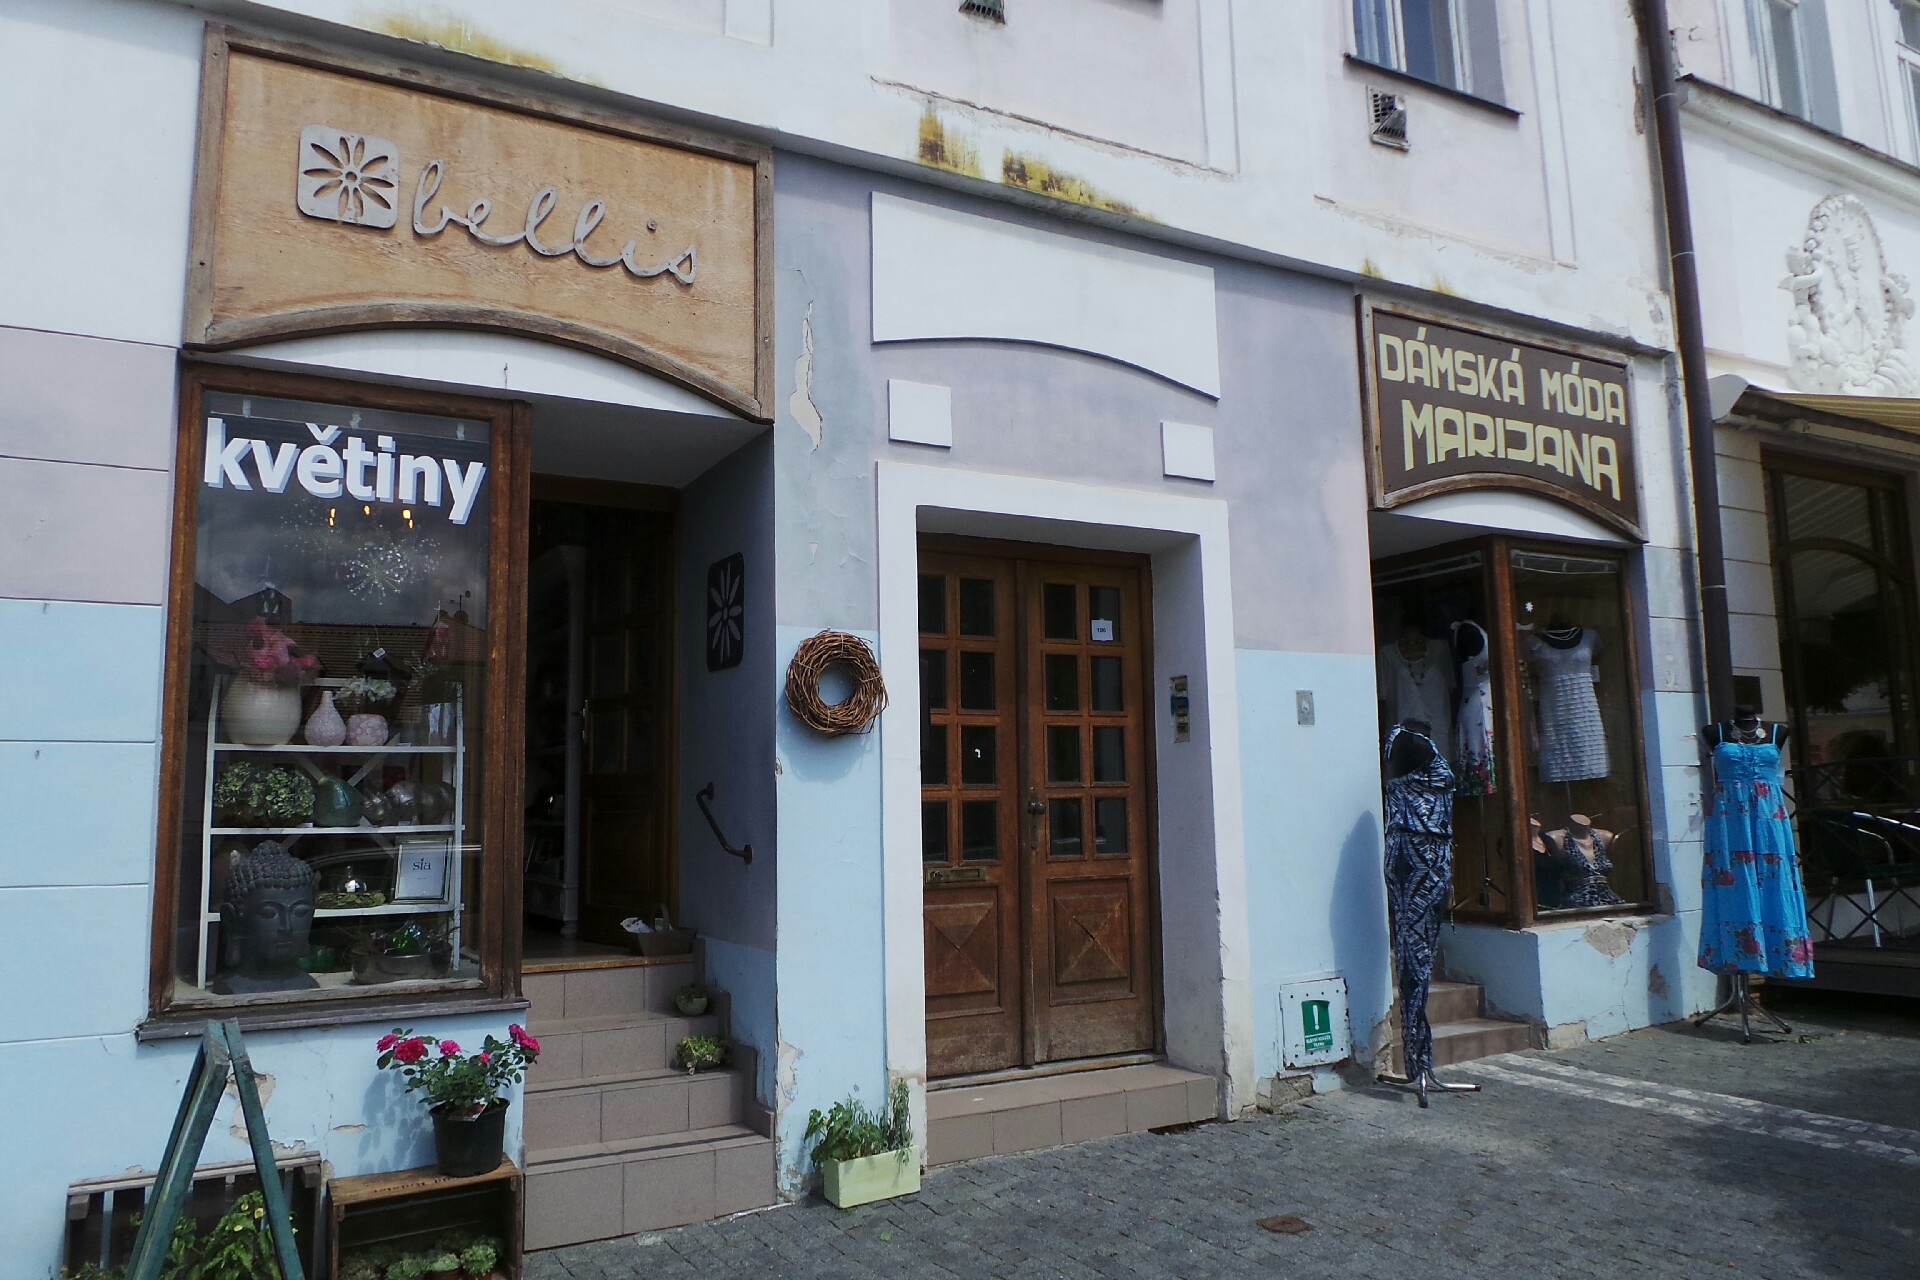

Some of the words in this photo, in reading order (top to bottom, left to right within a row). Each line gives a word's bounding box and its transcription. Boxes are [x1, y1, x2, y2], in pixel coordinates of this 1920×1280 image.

[412, 158, 697, 285] bellis
[1378, 326, 1526, 406] DÁMSKÁ
[1540, 361, 1627, 426] MÓDA
[203, 416, 487, 525] květiny
[1401, 399, 1622, 502] MARIJANA
[412, 857, 432, 871] sia
